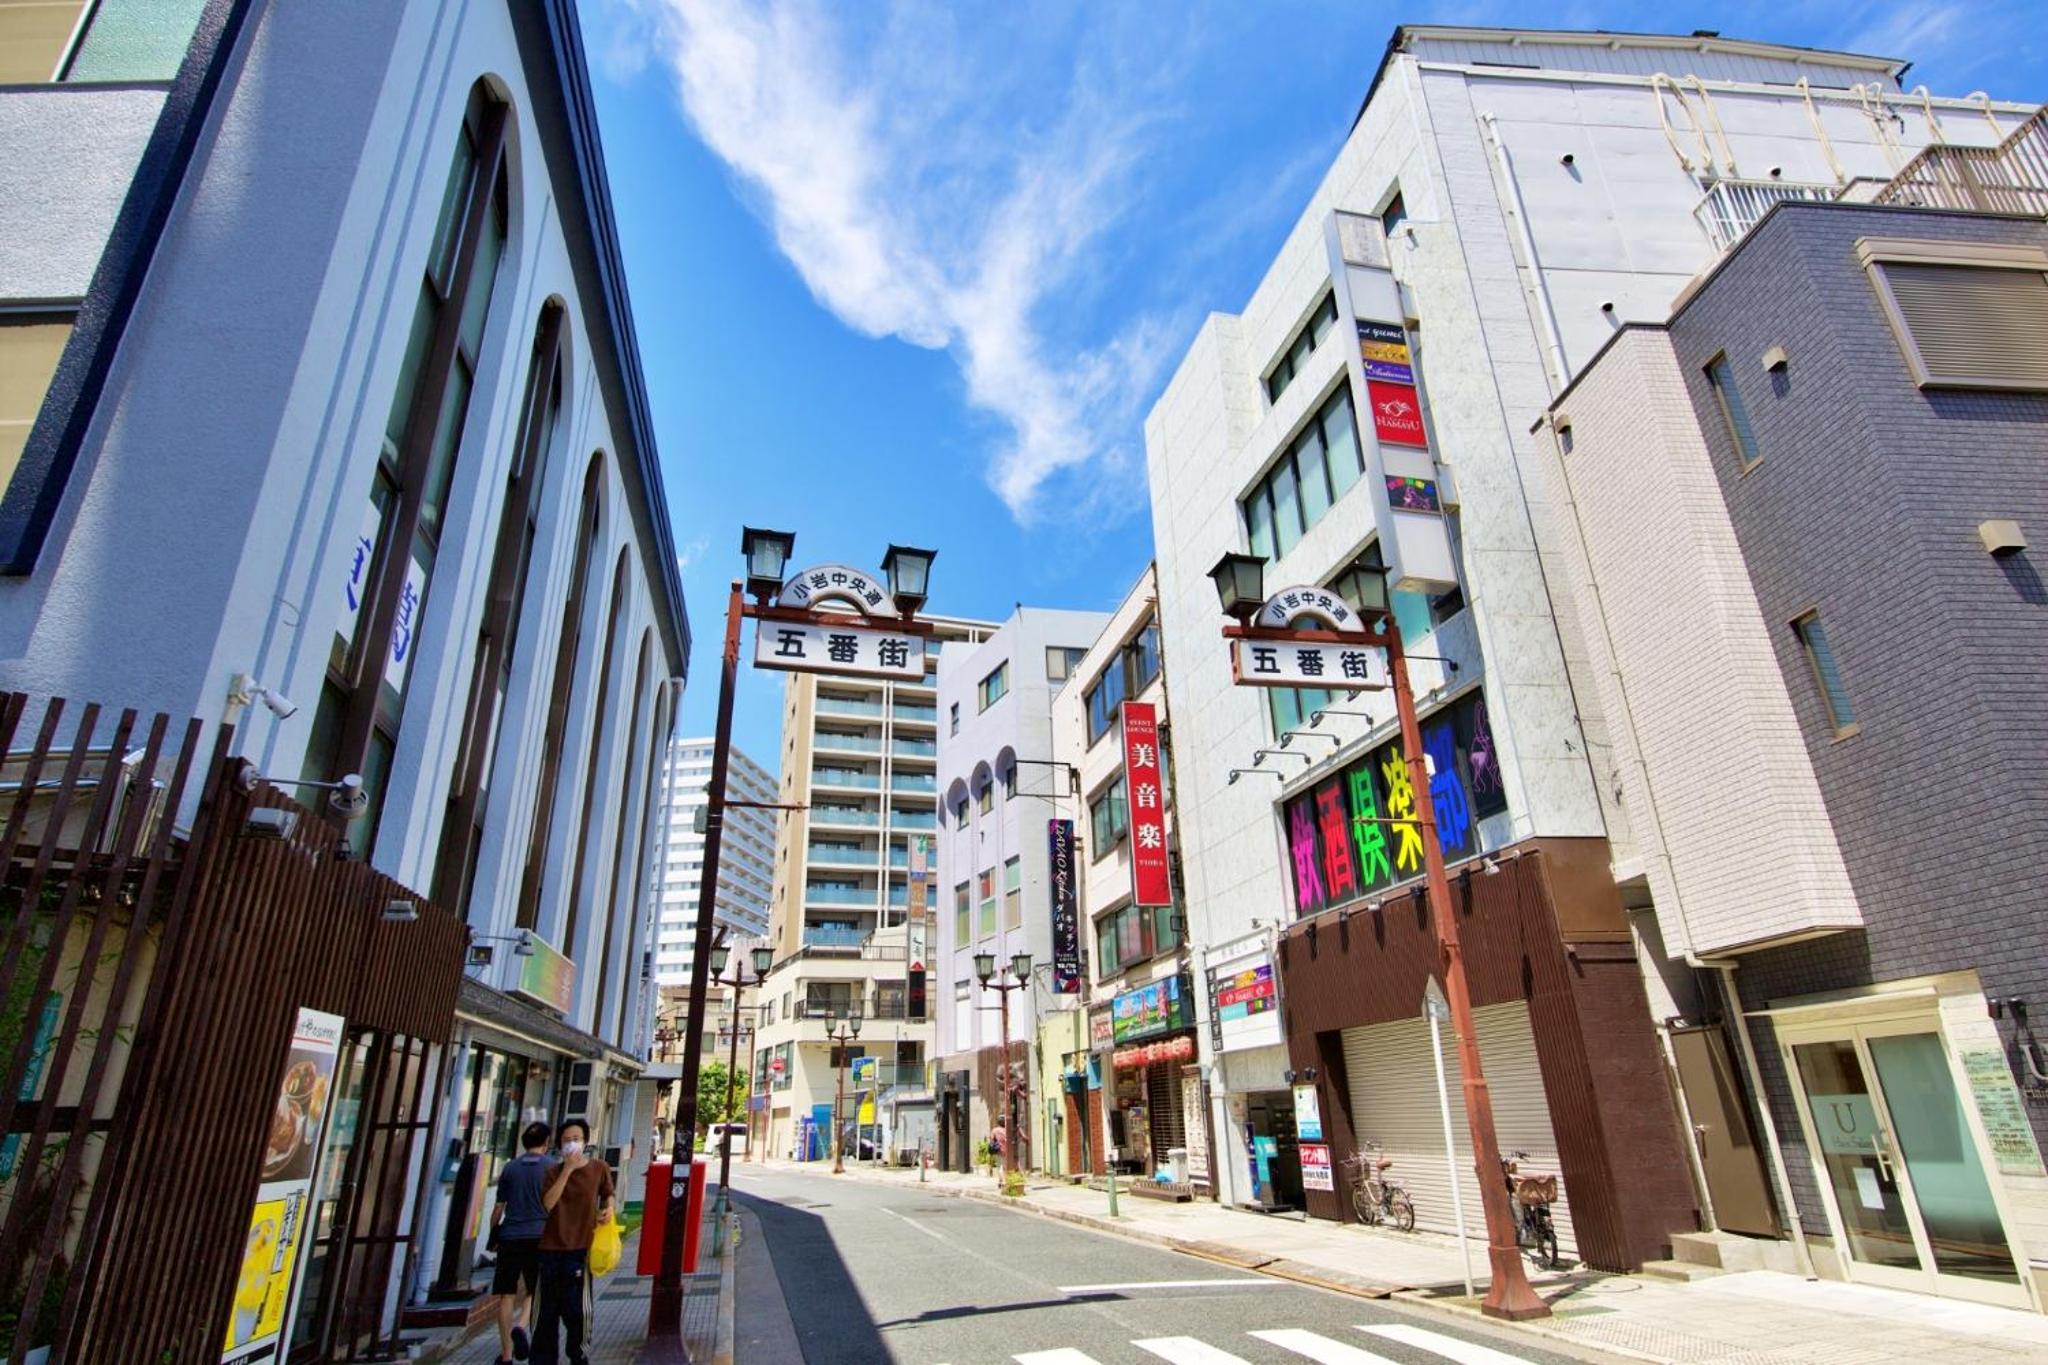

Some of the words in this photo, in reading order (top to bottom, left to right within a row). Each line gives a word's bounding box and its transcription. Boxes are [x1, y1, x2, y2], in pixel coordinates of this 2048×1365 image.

[793, 572, 883, 608] 小岩中央通
[1270, 591, 1349, 624] 小岩中央通
[775, 629, 909, 668] 五番街
[1252, 647, 1368, 679] 五番街
[1131, 743, 1162, 849] 美音楽
[1831, 1103, 1857, 1133] U
